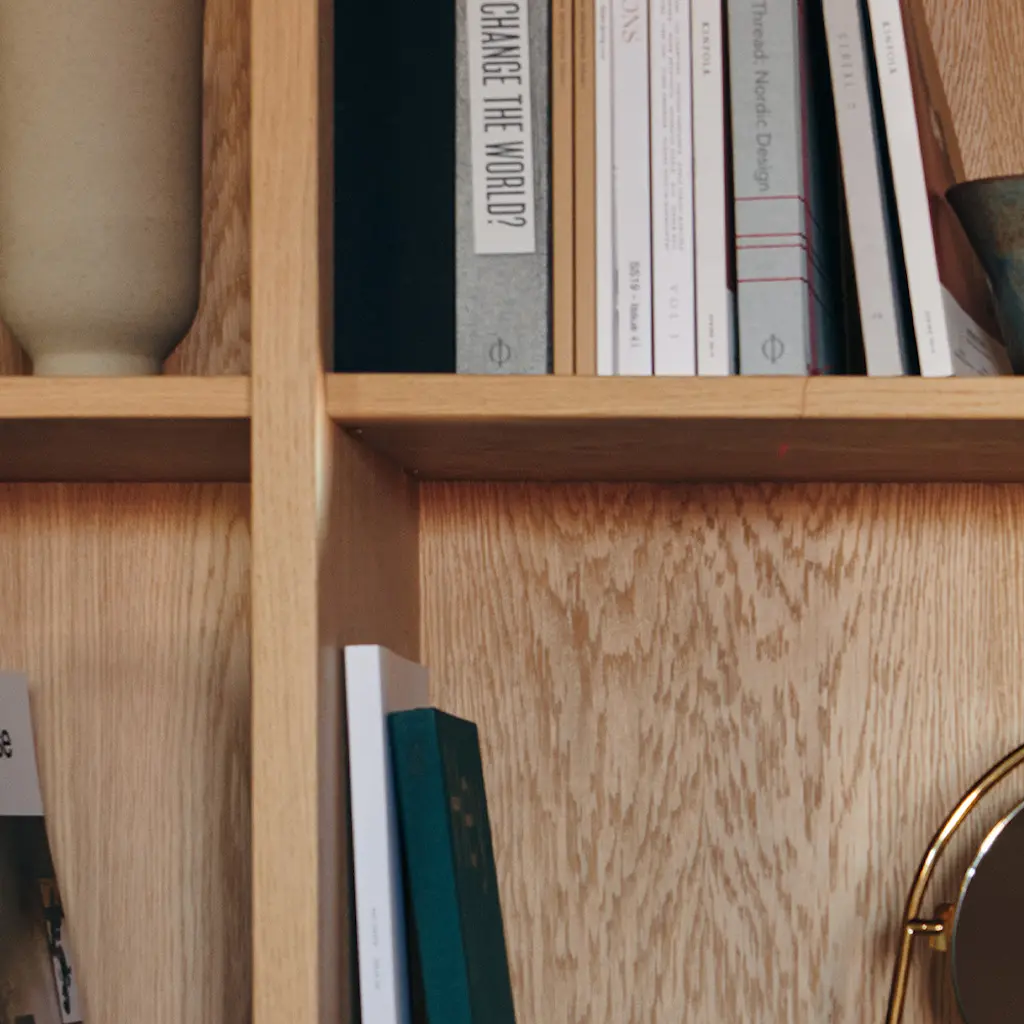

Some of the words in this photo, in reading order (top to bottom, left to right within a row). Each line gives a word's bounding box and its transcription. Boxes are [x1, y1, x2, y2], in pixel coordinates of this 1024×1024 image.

[480, 2, 523, 87] CHANGE
[484, 94, 524, 133] THE
[753, 69, 772, 128] Nordic
[485, 141, 527, 229] WORLD?
[753, 132, 773, 193] Design
